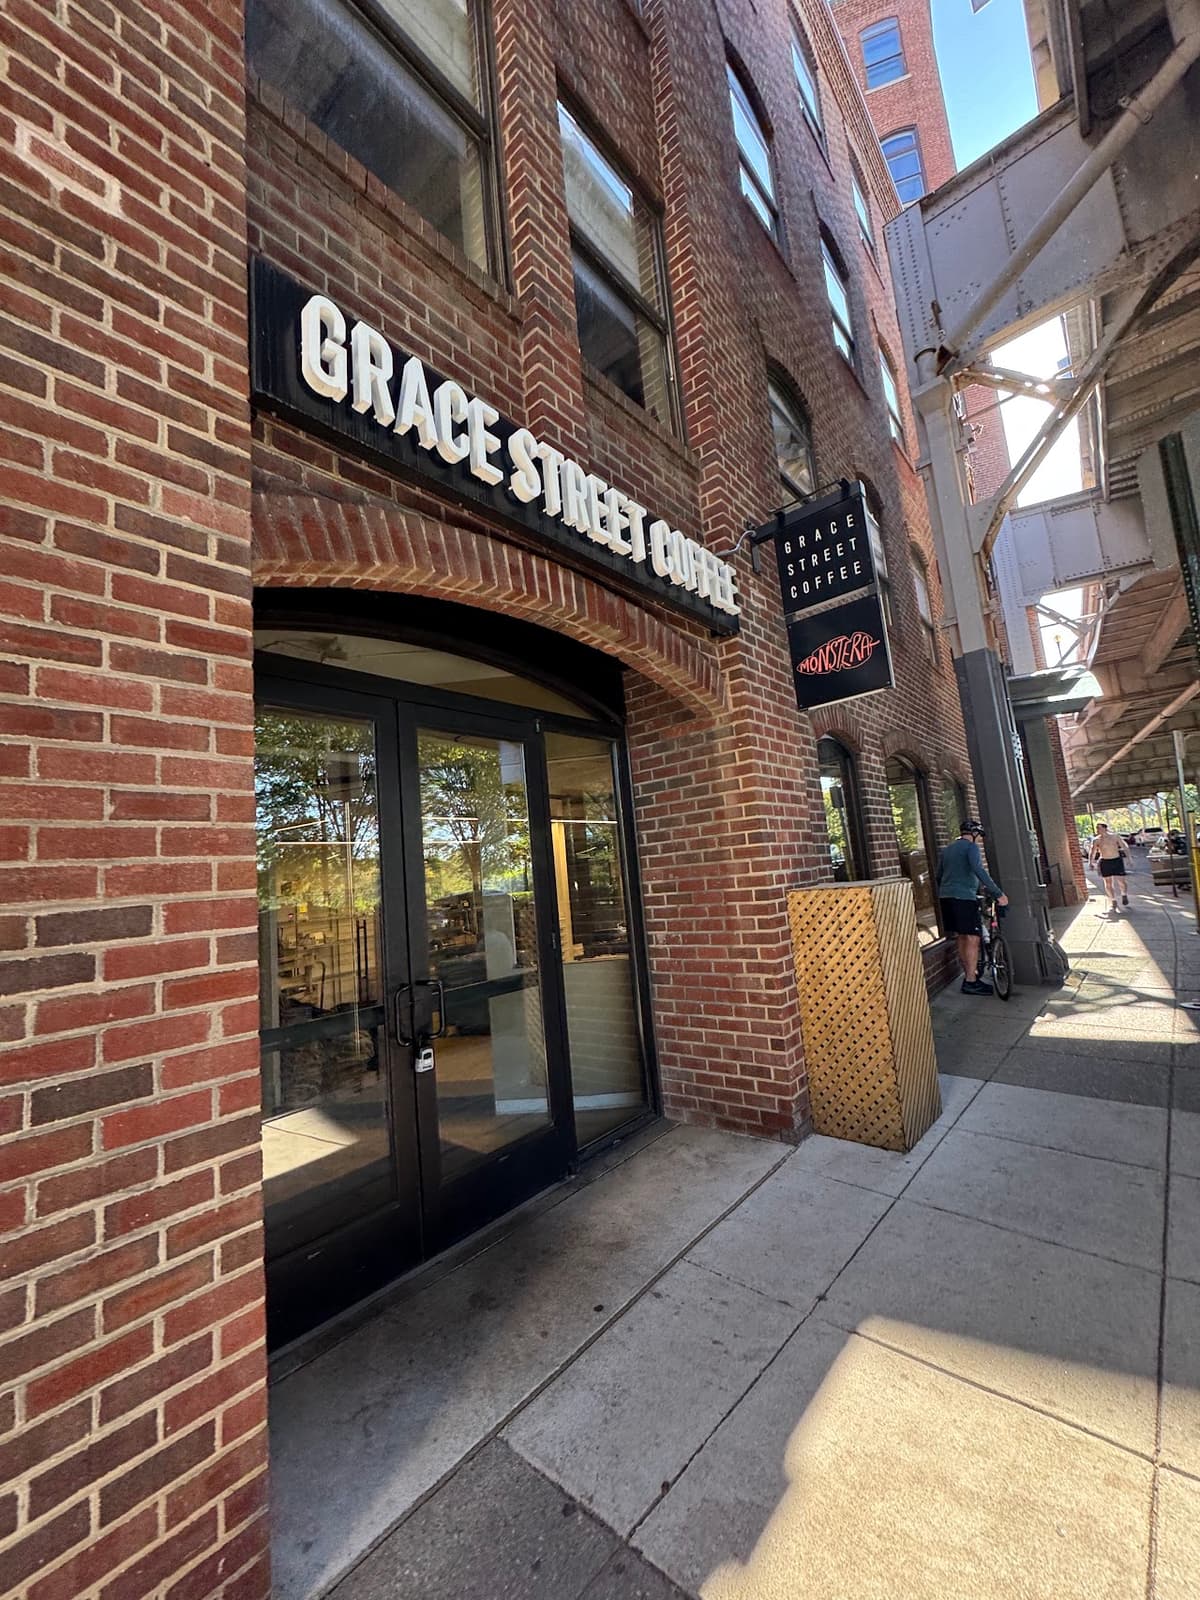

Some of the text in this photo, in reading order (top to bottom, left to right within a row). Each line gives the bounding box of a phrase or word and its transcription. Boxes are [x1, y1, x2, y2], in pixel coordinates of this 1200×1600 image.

[301, 295, 740, 615] GRACE STREET COFFEE
[784, 514, 854, 554] GRACE
[787, 537, 858, 576] STREET
[790, 561, 861, 598] COFFEE
[798, 632, 880, 674] MONSTERA
